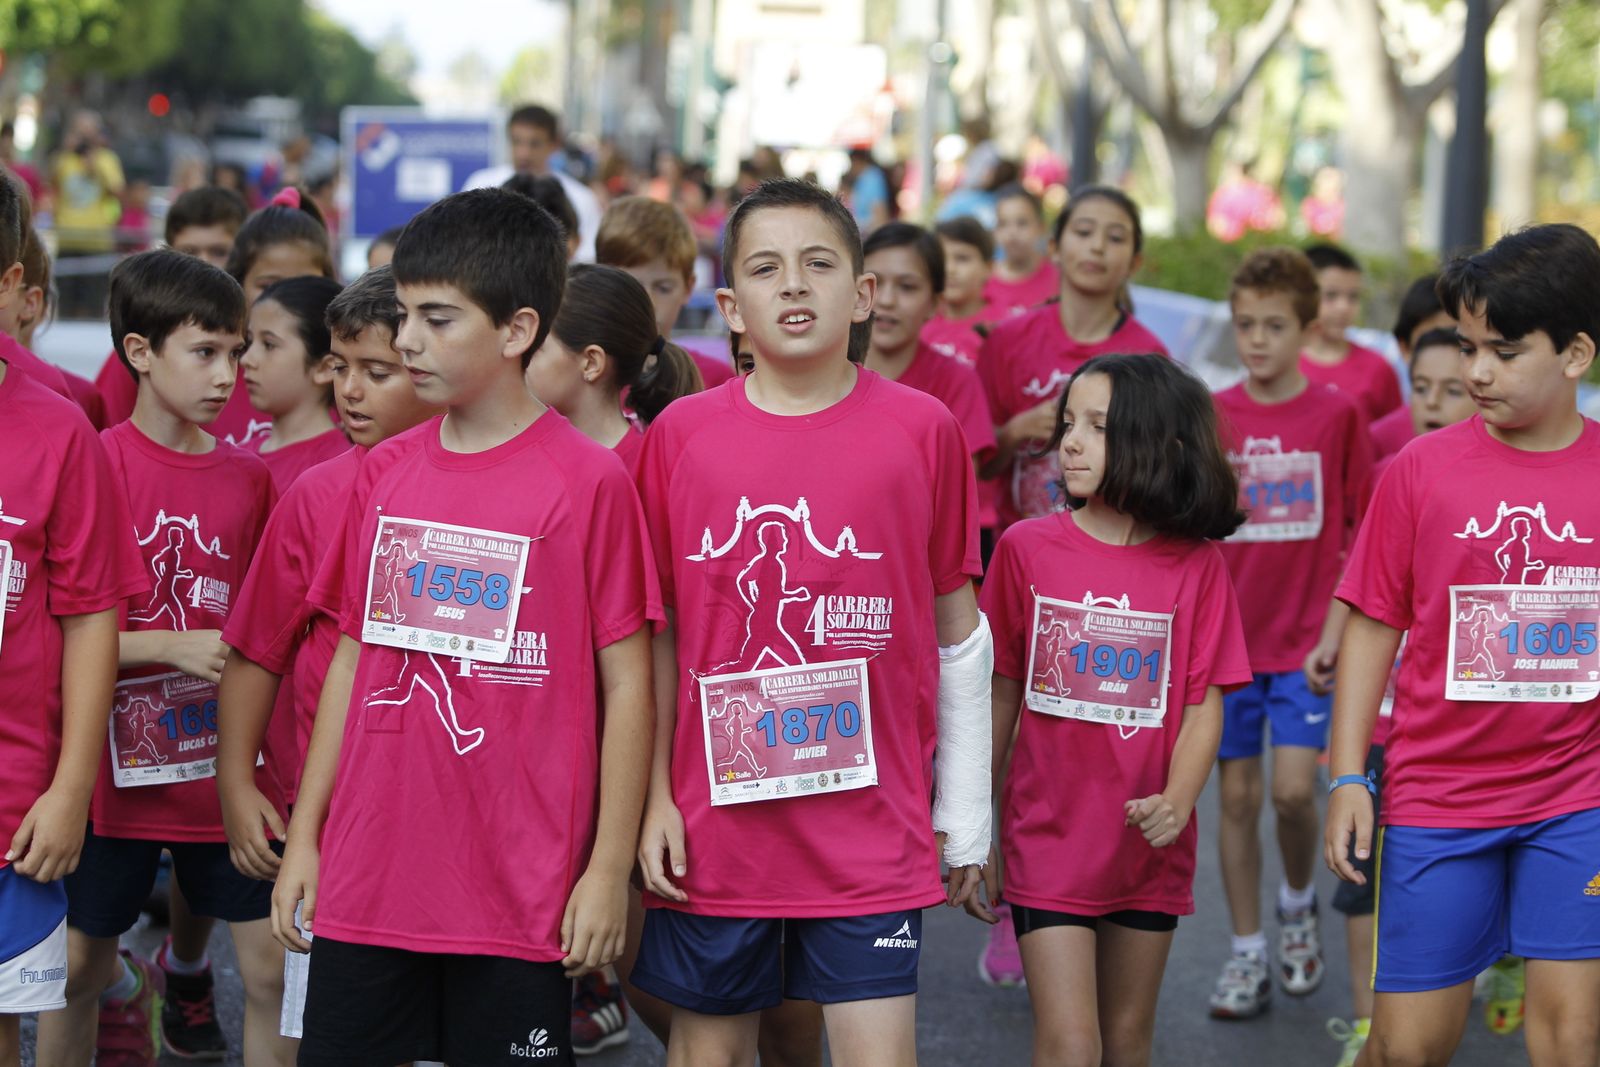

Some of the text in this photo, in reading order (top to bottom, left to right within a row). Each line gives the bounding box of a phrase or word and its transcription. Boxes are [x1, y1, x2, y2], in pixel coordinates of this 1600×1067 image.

[1245, 480, 1315, 507] 1704
[420, 528, 519, 555] 4 CARRERA SOLIDARIA
[186, 576, 203, 608] 4
[407, 561, 510, 610] 1558
[1516, 593, 1557, 603] CARRERA
[1557, 593, 1599, 603] SOLIDARIA
[434, 605, 466, 620] JESUS
[804, 595, 893, 646] 4 CARRERA
[826, 613, 890, 630] SOLIDARIA
[1081, 612, 1167, 631] 4 CARRERA SOLIDARIA
[1500, 622, 1597, 656] 1605
[1070, 641, 1161, 682] 1901
[1513, 658, 1579, 669] JOSE MANUEL
[730, 681, 755, 694] NIÑOS
[758, 668, 858, 699] 4 CARRERA SOLIDARIA
[1098, 680, 1129, 694] ARÁN
[757, 701, 861, 747] 1870
[178, 737, 206, 752] LUCAS
[793, 745, 827, 760] JAVIER
[873, 937, 918, 949] MERCURY
